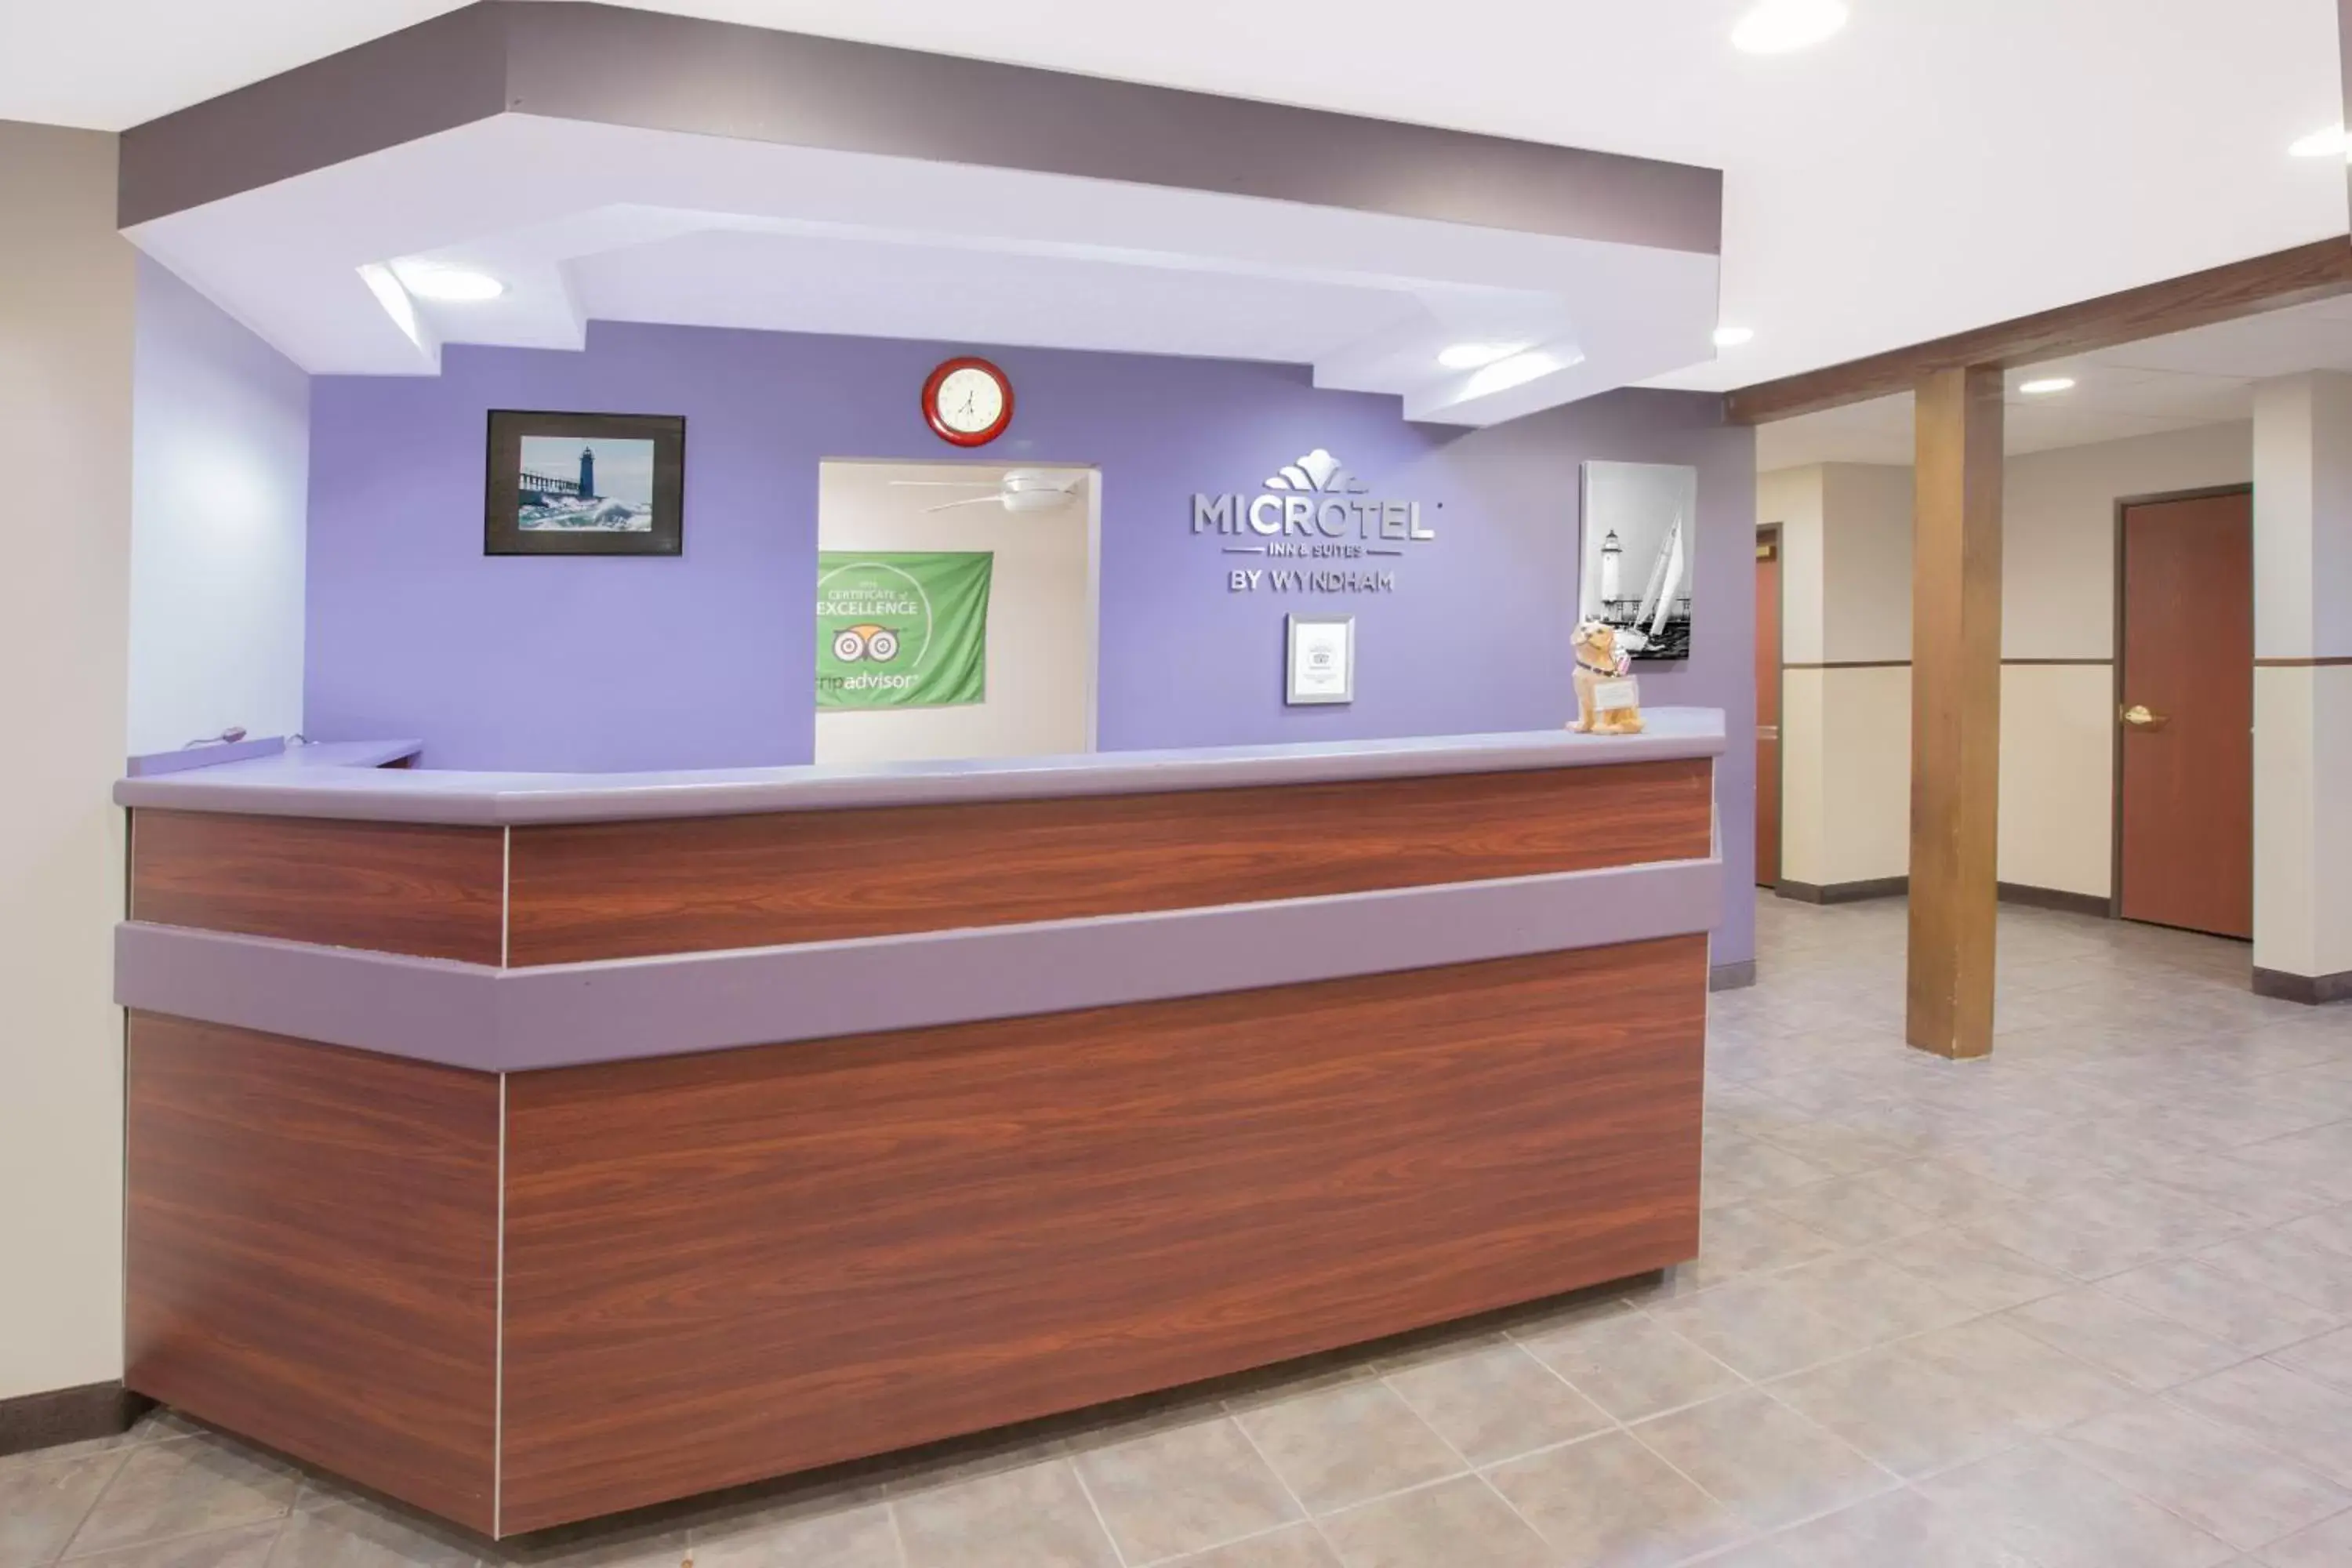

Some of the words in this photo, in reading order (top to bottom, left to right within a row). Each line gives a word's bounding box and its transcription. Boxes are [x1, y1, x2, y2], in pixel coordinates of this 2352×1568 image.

[1191, 493, 1435, 541] MICROTEL
[1267, 542, 1294, 557] INN
[1312, 544, 1363, 559] SUITES
[1229, 568, 1262, 592] BY
[1269, 569, 1395, 593] WYNDHAM
[828, 590, 895, 601] CERTIFICATE
[816, 601, 918, 615] EXCELLENCE
